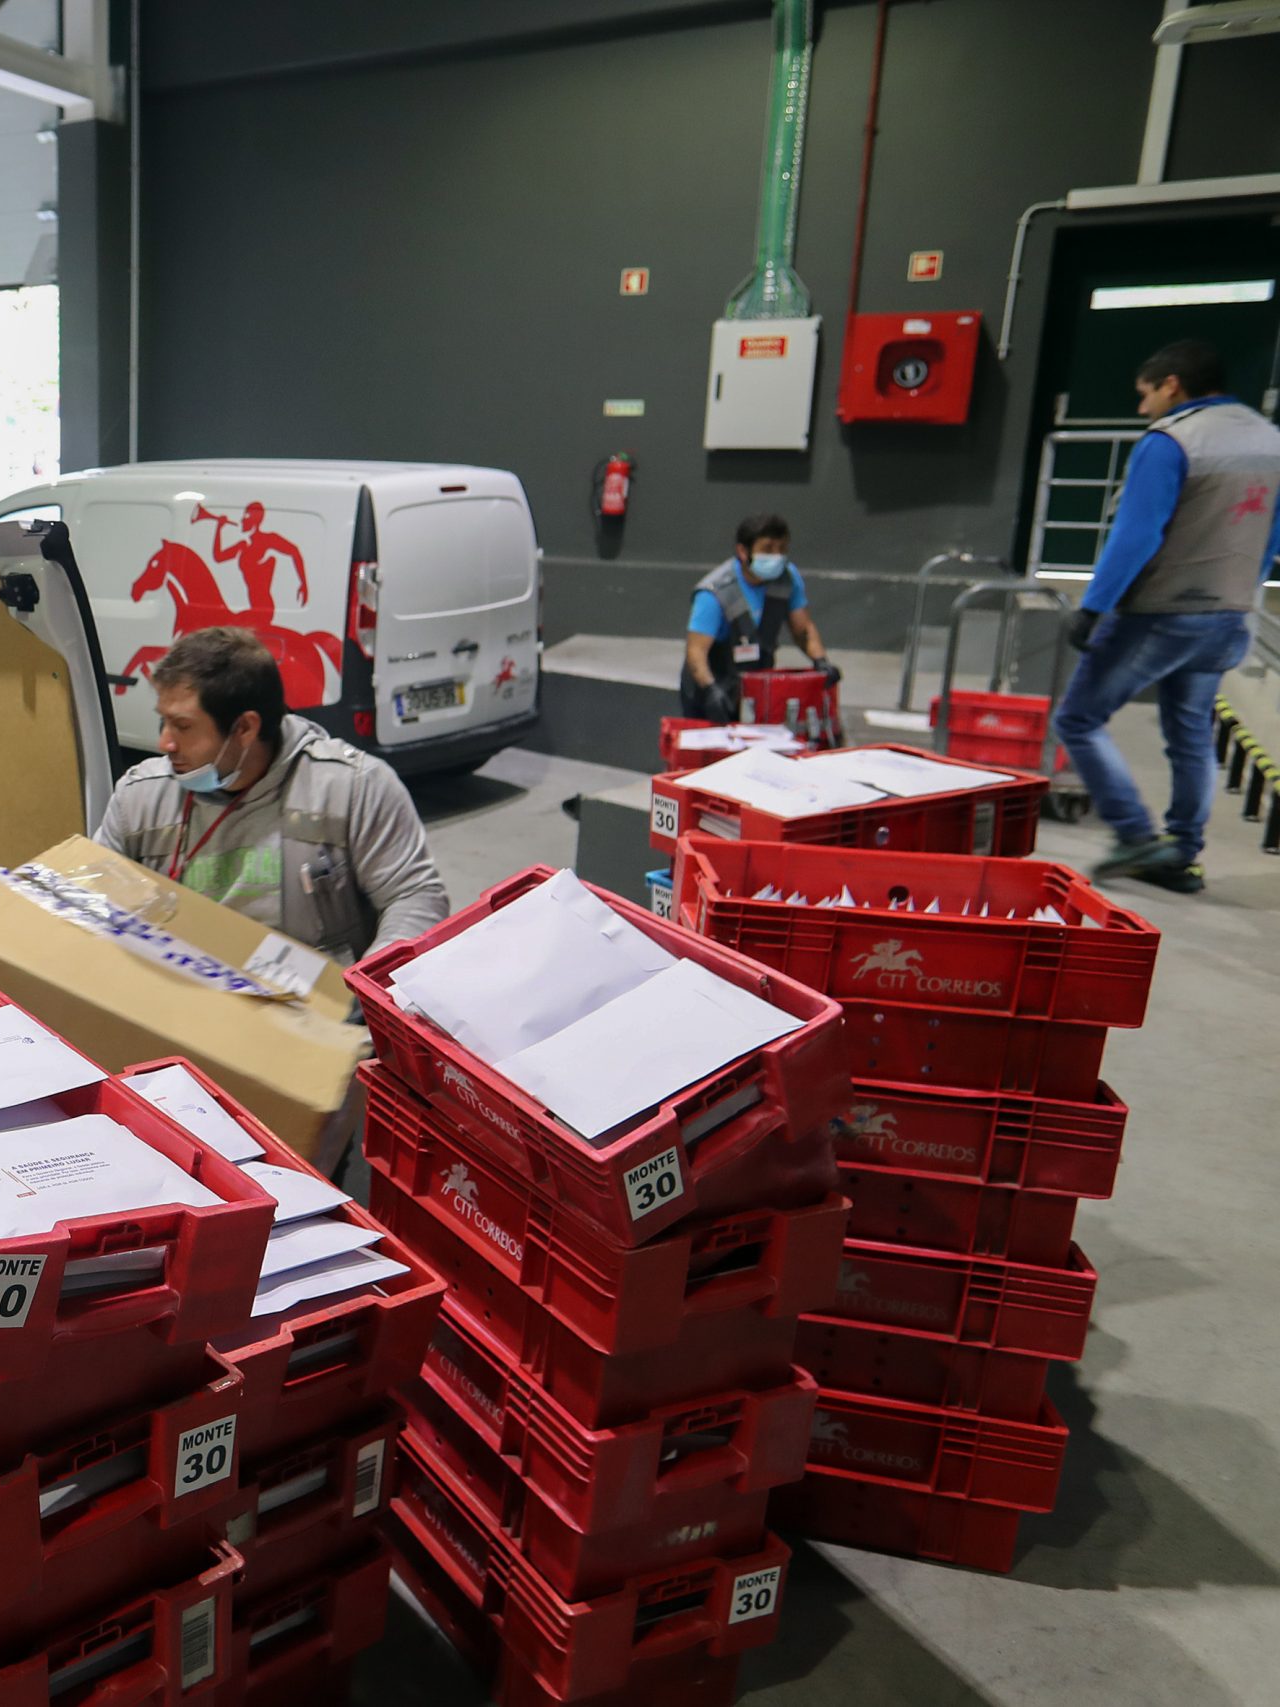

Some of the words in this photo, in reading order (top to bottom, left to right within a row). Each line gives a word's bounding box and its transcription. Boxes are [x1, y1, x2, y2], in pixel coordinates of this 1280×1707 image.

[654, 797, 676, 811] MONTE
[655, 810, 675, 832] 30
[655, 887, 673, 900] MONT
[877, 972, 909, 989] CTT
[916, 975, 1002, 998] CORREIOS
[891, 1139, 976, 1163] CORREIOS
[628, 1150, 676, 1186] MONTE
[634, 1171, 677, 1211] 30
[453, 1194, 473, 1220] CTT
[473, 1210, 523, 1261] CORREIOS
[460, 1375, 505, 1425] CORREIO
[182, 1421, 233, 1452] MONTE
[182, 1444, 227, 1484] 30
[736, 1570, 778, 1591] MONTE
[735, 1587, 772, 1616] 30
